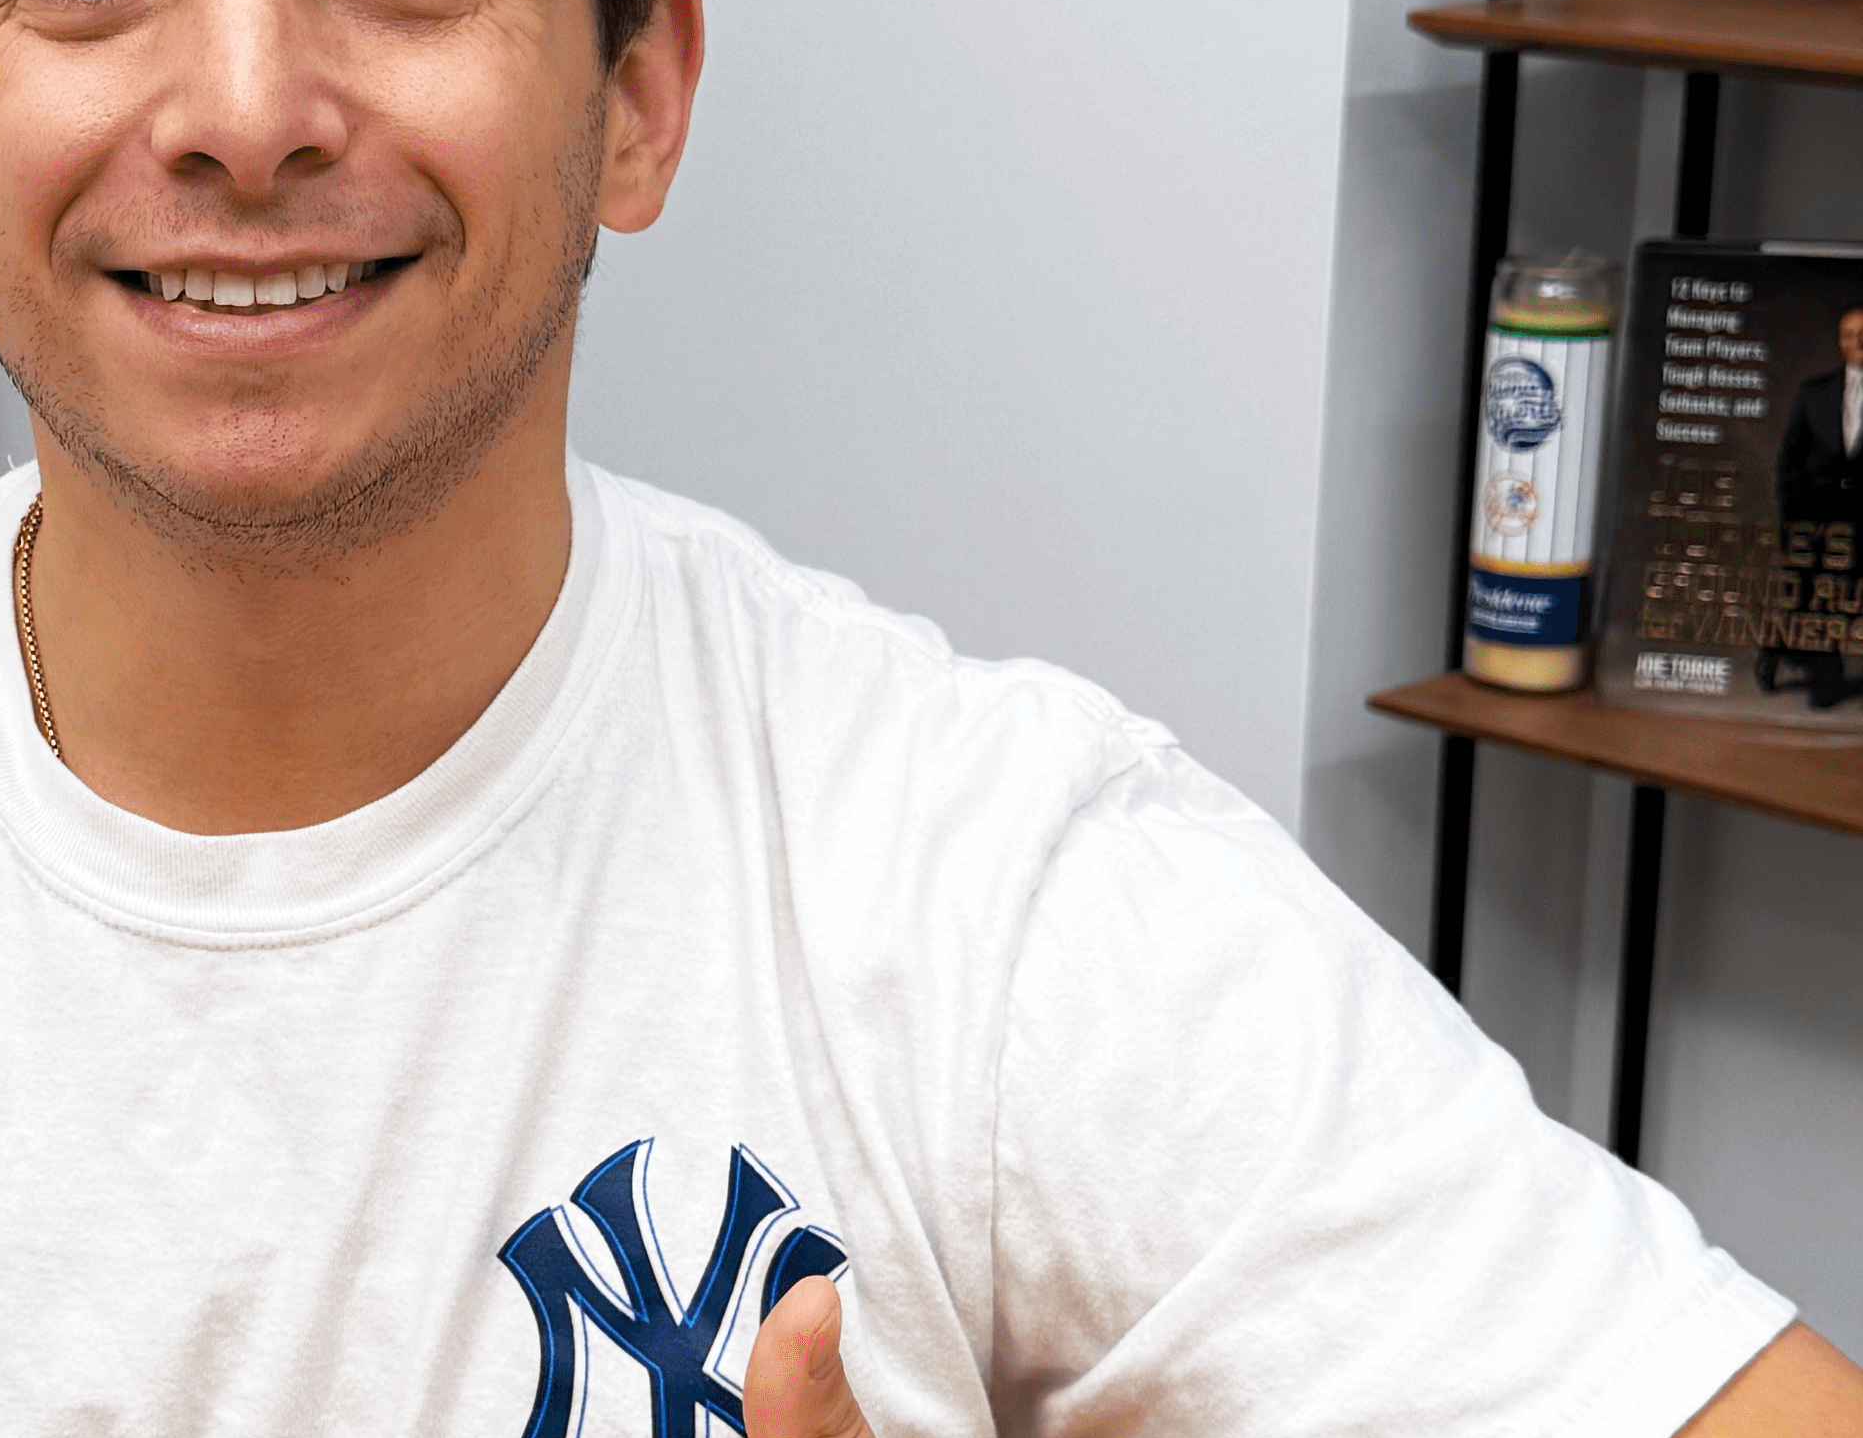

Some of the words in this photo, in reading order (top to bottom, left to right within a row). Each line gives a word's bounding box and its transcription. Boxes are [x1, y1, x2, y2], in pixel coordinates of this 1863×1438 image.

[1691, 278, 1730, 304] Keys
[1666, 305, 1742, 333] Managing
[1636, 651, 1671, 677] JOE
